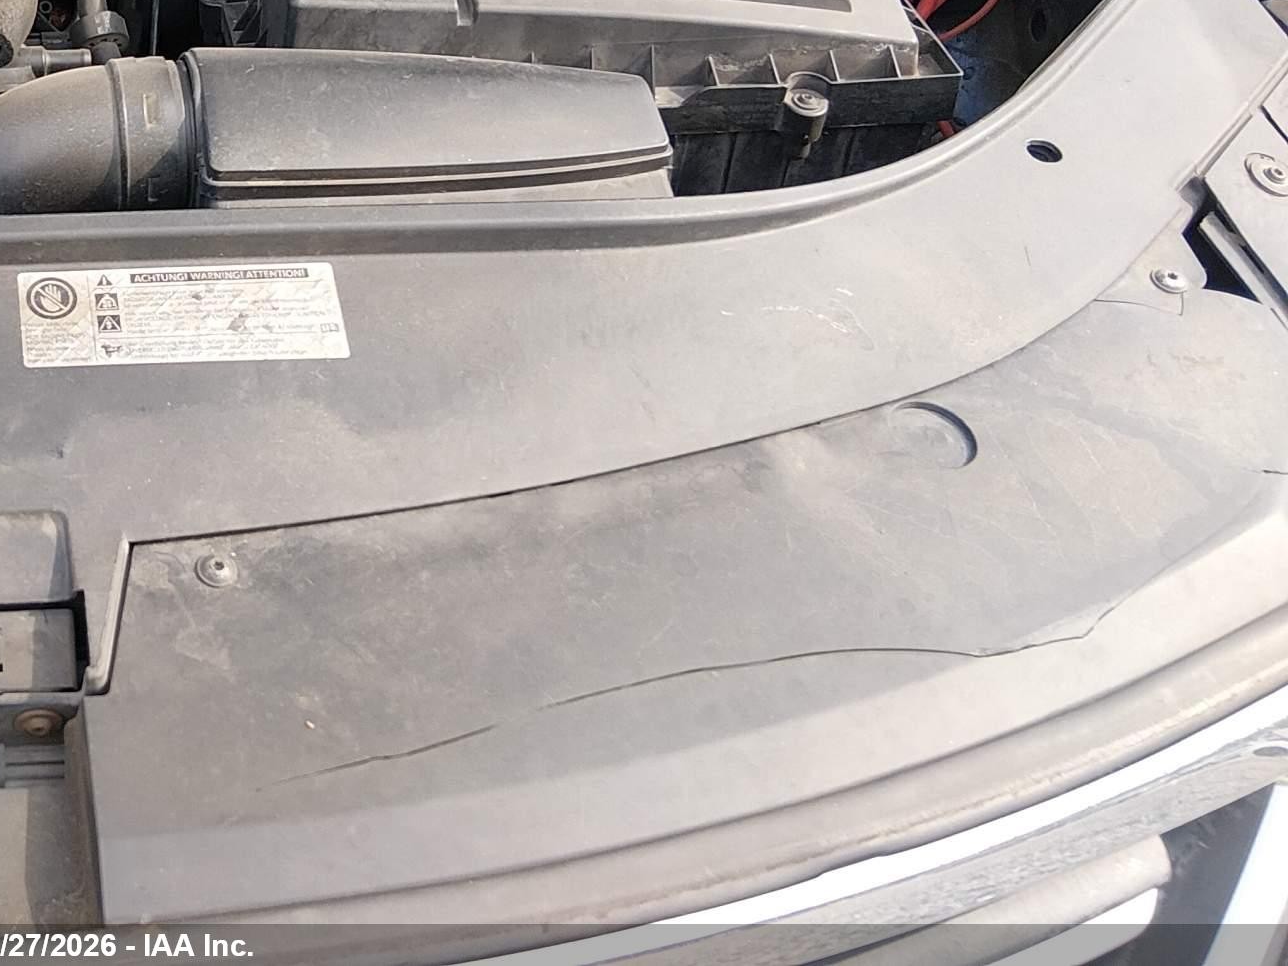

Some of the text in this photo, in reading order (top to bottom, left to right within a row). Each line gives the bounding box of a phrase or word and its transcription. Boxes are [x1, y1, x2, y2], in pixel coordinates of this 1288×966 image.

[134, 268, 305, 283] ACHTUNG! WARNING! ATTENTION!
